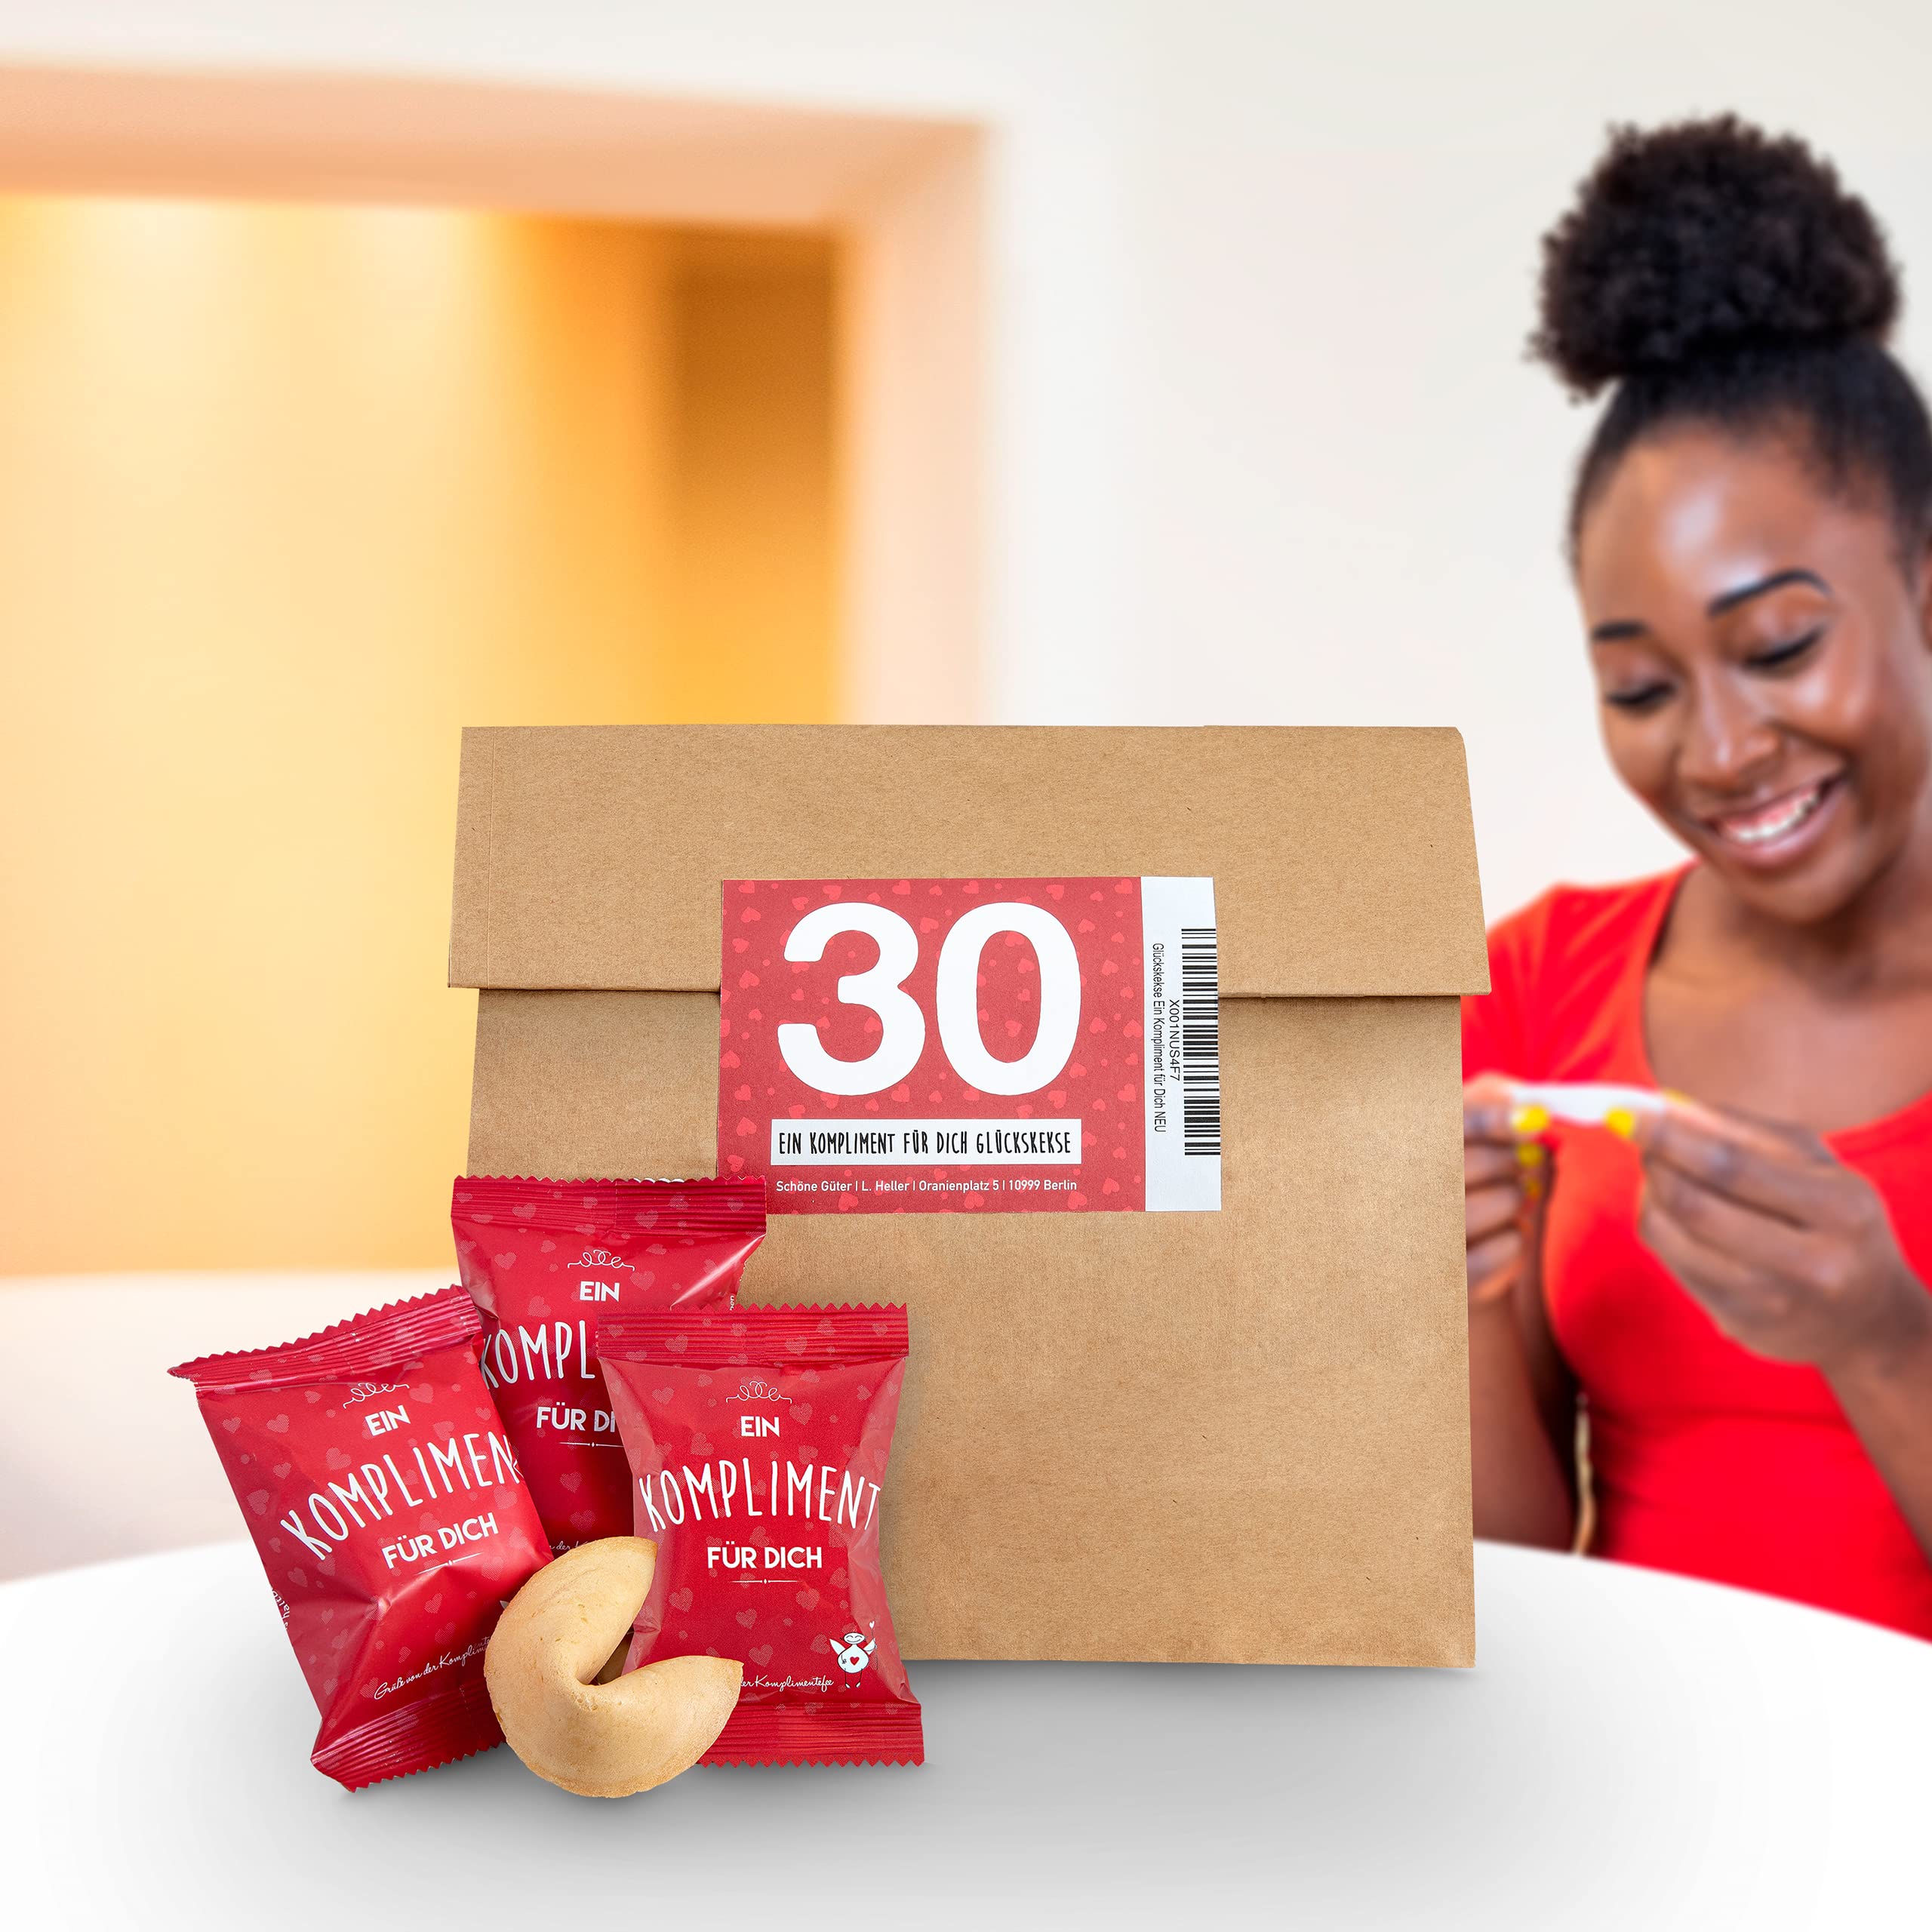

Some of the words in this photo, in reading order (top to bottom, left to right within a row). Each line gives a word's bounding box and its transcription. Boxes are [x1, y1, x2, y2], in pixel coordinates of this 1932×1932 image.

[1152, 943, 1164, 998] Glückskekse
[777, 902, 1081, 1096] 30
[1153, 1001, 1165, 1015] Ein
[1151, 1018, 1165, 1071] Kompliment
[1169, 999, 1180, 1081] X001NUS4F7
[1153, 1074, 1166, 1086] für
[1154, 1088, 1166, 1109] Dich
[1154, 1111, 1167, 1132] NEU
[779, 1132, 801, 1154] EIN
[810, 1132, 895, 1154] KOMPLIMENT
[903, 1130, 928, 1154] FÜR
[937, 1131, 968, 1154] DICH
[977, 1129, 1071, 1154] GLÜCKSKEKSE
[776, 1180, 817, 1192] Schöne
[821, 1180, 852, 1192] Güter
[861, 1181, 872, 1192] L.
[875, 1180, 909, 1192] Heller
[918, 1180, 989, 1192] Oranienplatz
[992, 1180, 999, 1190] 5
[1009, 1180, 1041, 1190] 10999
[1044, 1180, 1077, 1190] Berlin
[580, 1281, 620, 1302] EIN
[481, 1320, 595, 1389] KOMPL
[364, 1404, 411, 1436] EIN
[537, 1401, 586, 1431] FÜR
[594, 1410, 616, 1432] DI
[740, 1416, 780, 1437] EIN
[638, 1457, 881, 1532] KOMPLIMENT
[381, 1532, 435, 1570] FÜR
[445, 1515, 499, 1551] DICH
[707, 1541, 757, 1570] FÜR
[764, 1547, 822, 1569] DICH
[374, 1676, 405, 1700] Grüße
[405, 1672, 423, 1684] von
[423, 1663, 438, 1676] der
[755, 1674, 834, 1692] Komplimentefee
